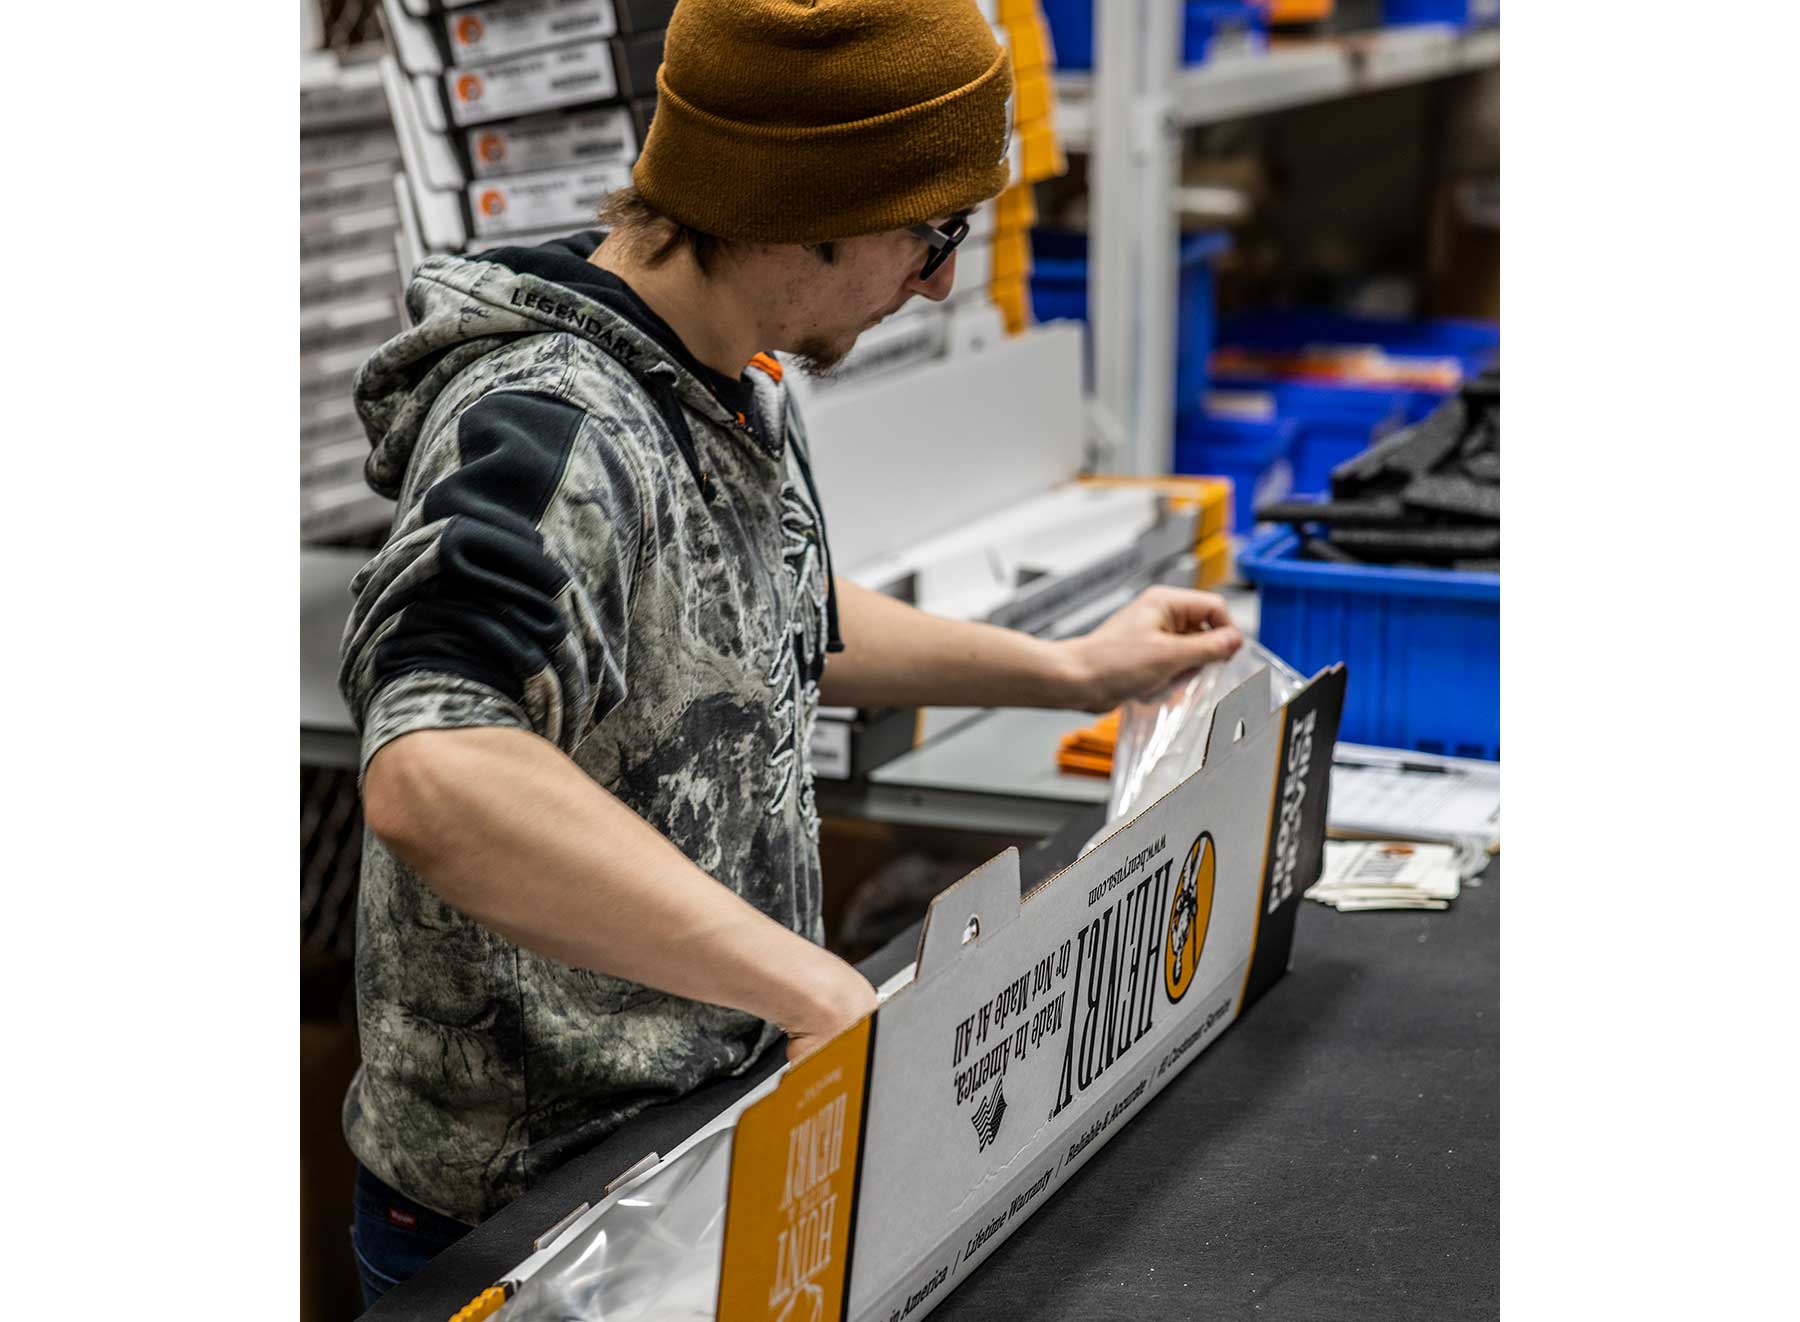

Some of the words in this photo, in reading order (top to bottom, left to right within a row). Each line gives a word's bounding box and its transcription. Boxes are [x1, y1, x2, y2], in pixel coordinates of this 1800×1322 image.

[510, 288, 643, 365] LEGENDARY
[1088, 834, 1167, 908] www.henryusa.com
[1032, 951, 1056, 1002] Not
[1055, 938, 1071, 980] Or
[976, 1000, 994, 1046] At
[994, 970, 1031, 1030] Made
[1031, 990, 1066, 1049] Made
[952, 1014, 976, 1068] All
[953, 1034, 1014, 1106] America,
[1014, 1020, 1031, 1061] In
[900, 1265, 949, 1321] America
[963, 1211, 1008, 1262] Lifetime
[1007, 1167, 1054, 1221] Warranty
[1064, 1119, 1103, 1167] Reliable
[768, 1193, 838, 1309] HUNT
